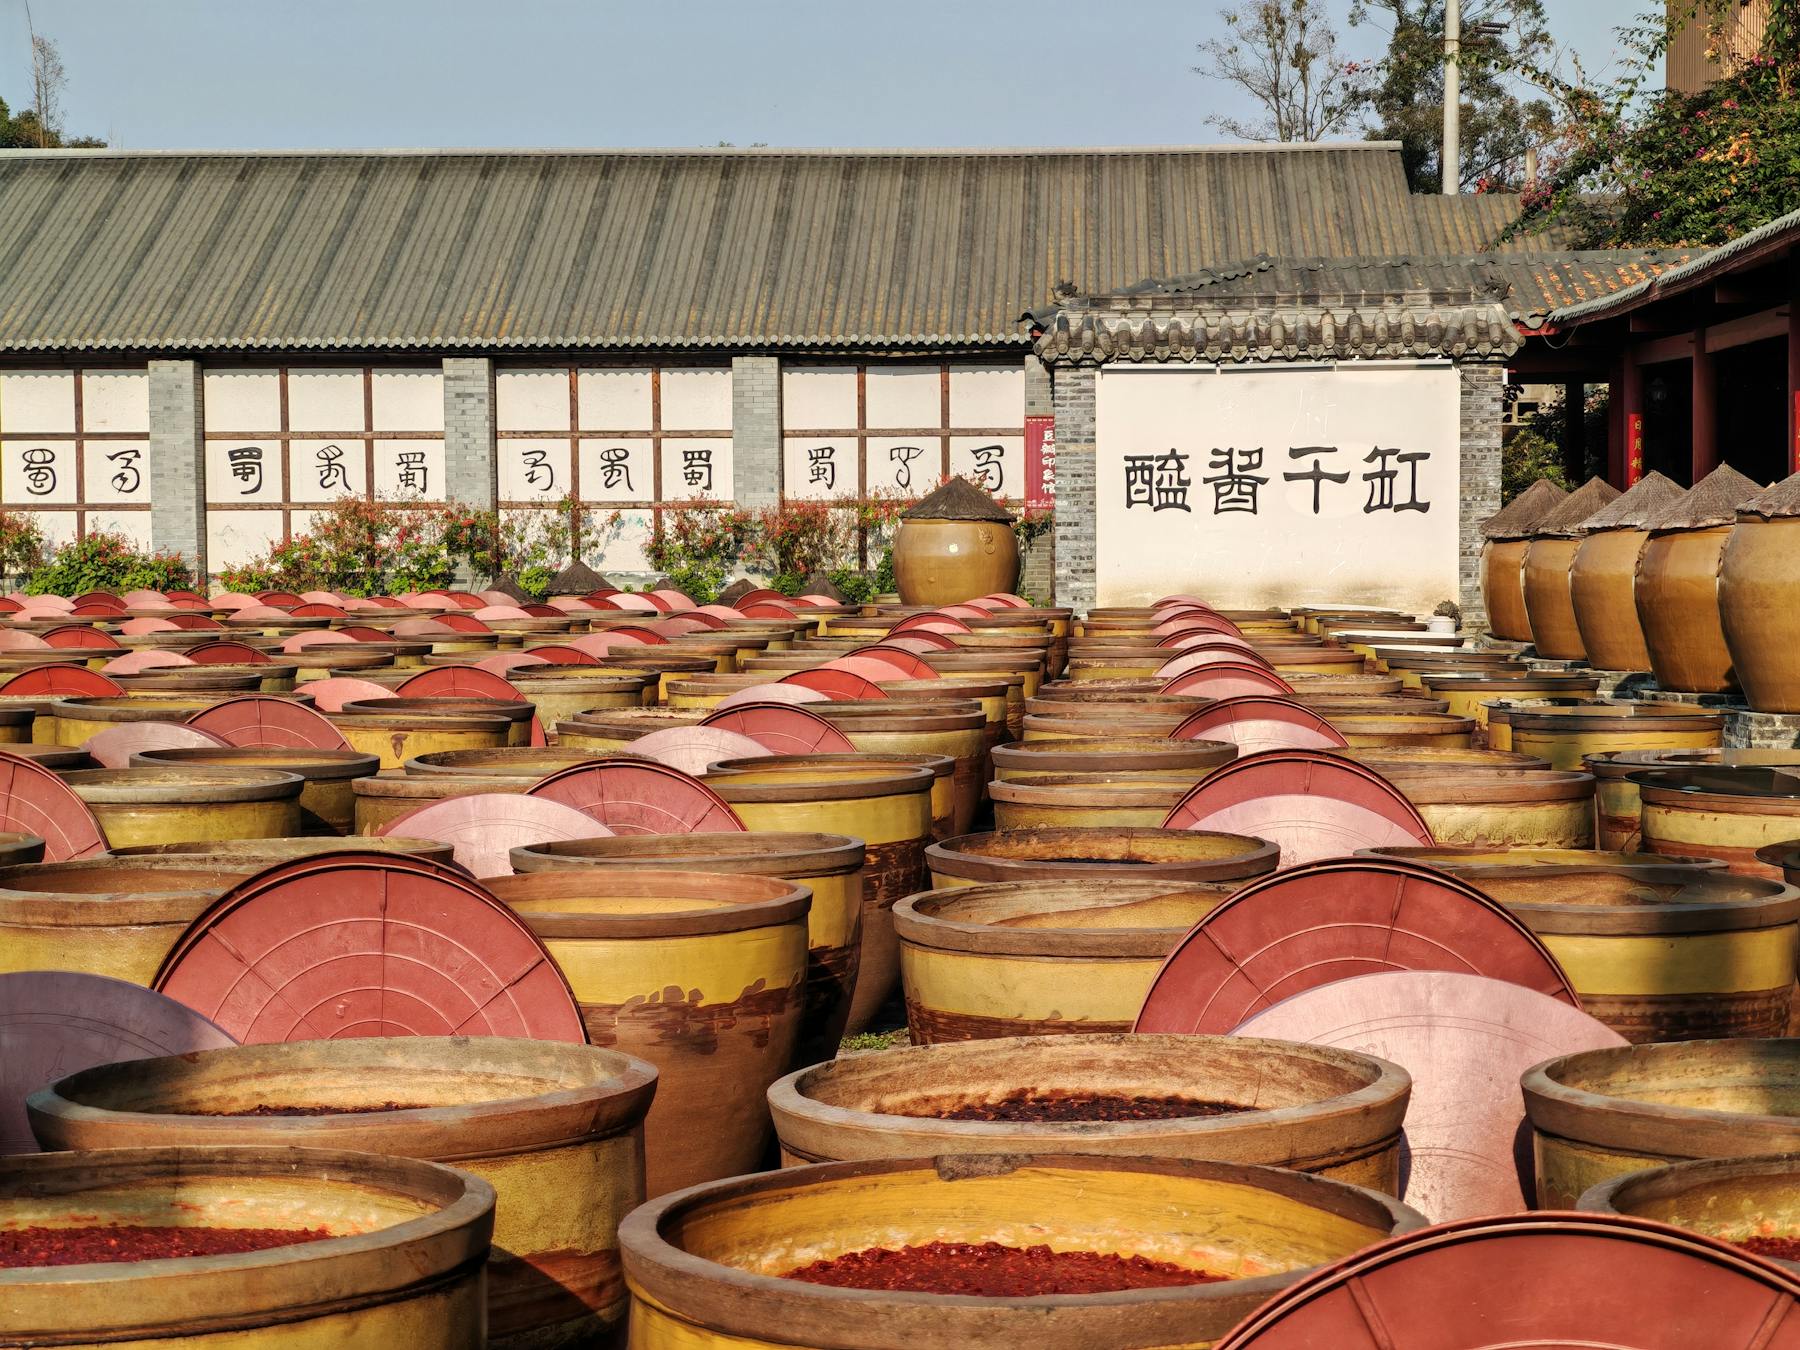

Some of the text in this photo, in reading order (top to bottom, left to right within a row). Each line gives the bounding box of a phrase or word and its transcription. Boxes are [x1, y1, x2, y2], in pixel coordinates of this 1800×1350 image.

[228, 446, 263, 495] 蜀
[396, 451, 428, 494] 蜀
[682, 449, 713, 491] 蜀
[807, 446, 836, 490] 蜀
